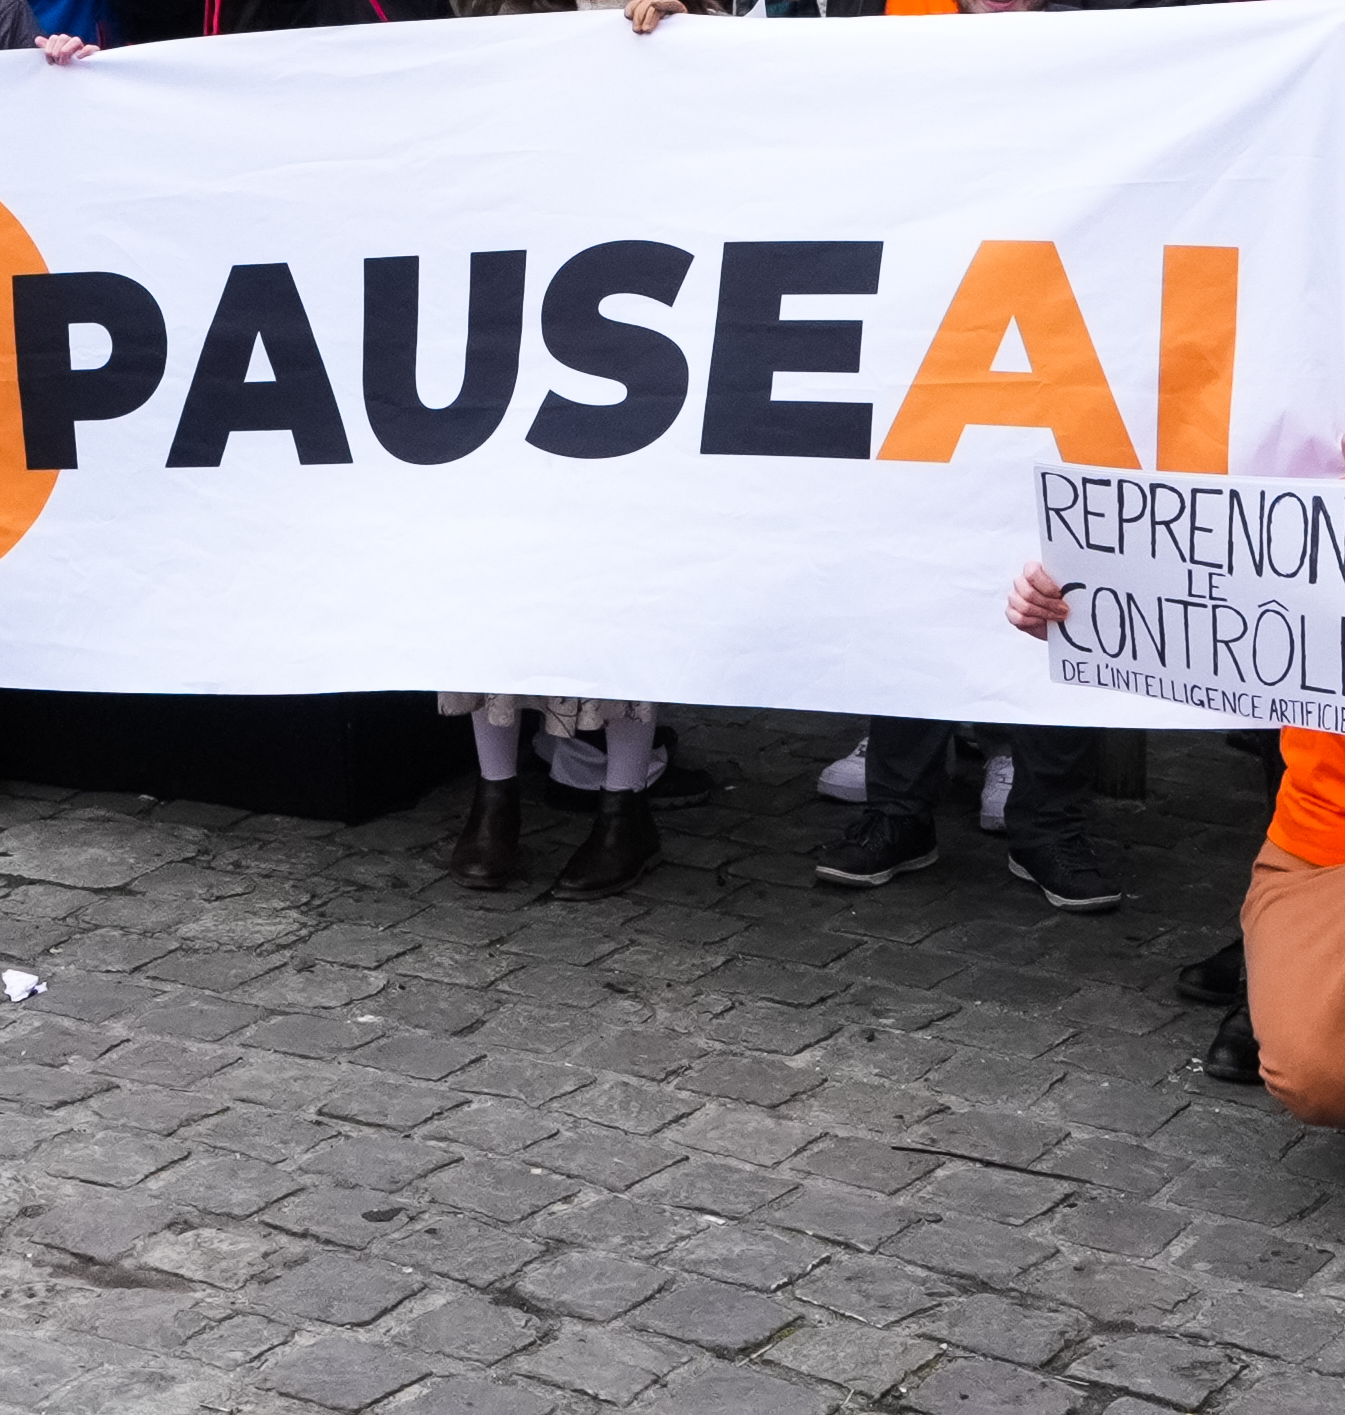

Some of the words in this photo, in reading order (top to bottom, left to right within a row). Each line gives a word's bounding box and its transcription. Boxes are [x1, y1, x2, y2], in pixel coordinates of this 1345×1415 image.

[10, 238, 1239, 475] PAUSEAI
[1187, 569, 1228, 602] LE
[1062, 659, 1092, 684] DE
[1096, 662, 1264, 721] L'INTELLIGENCE
